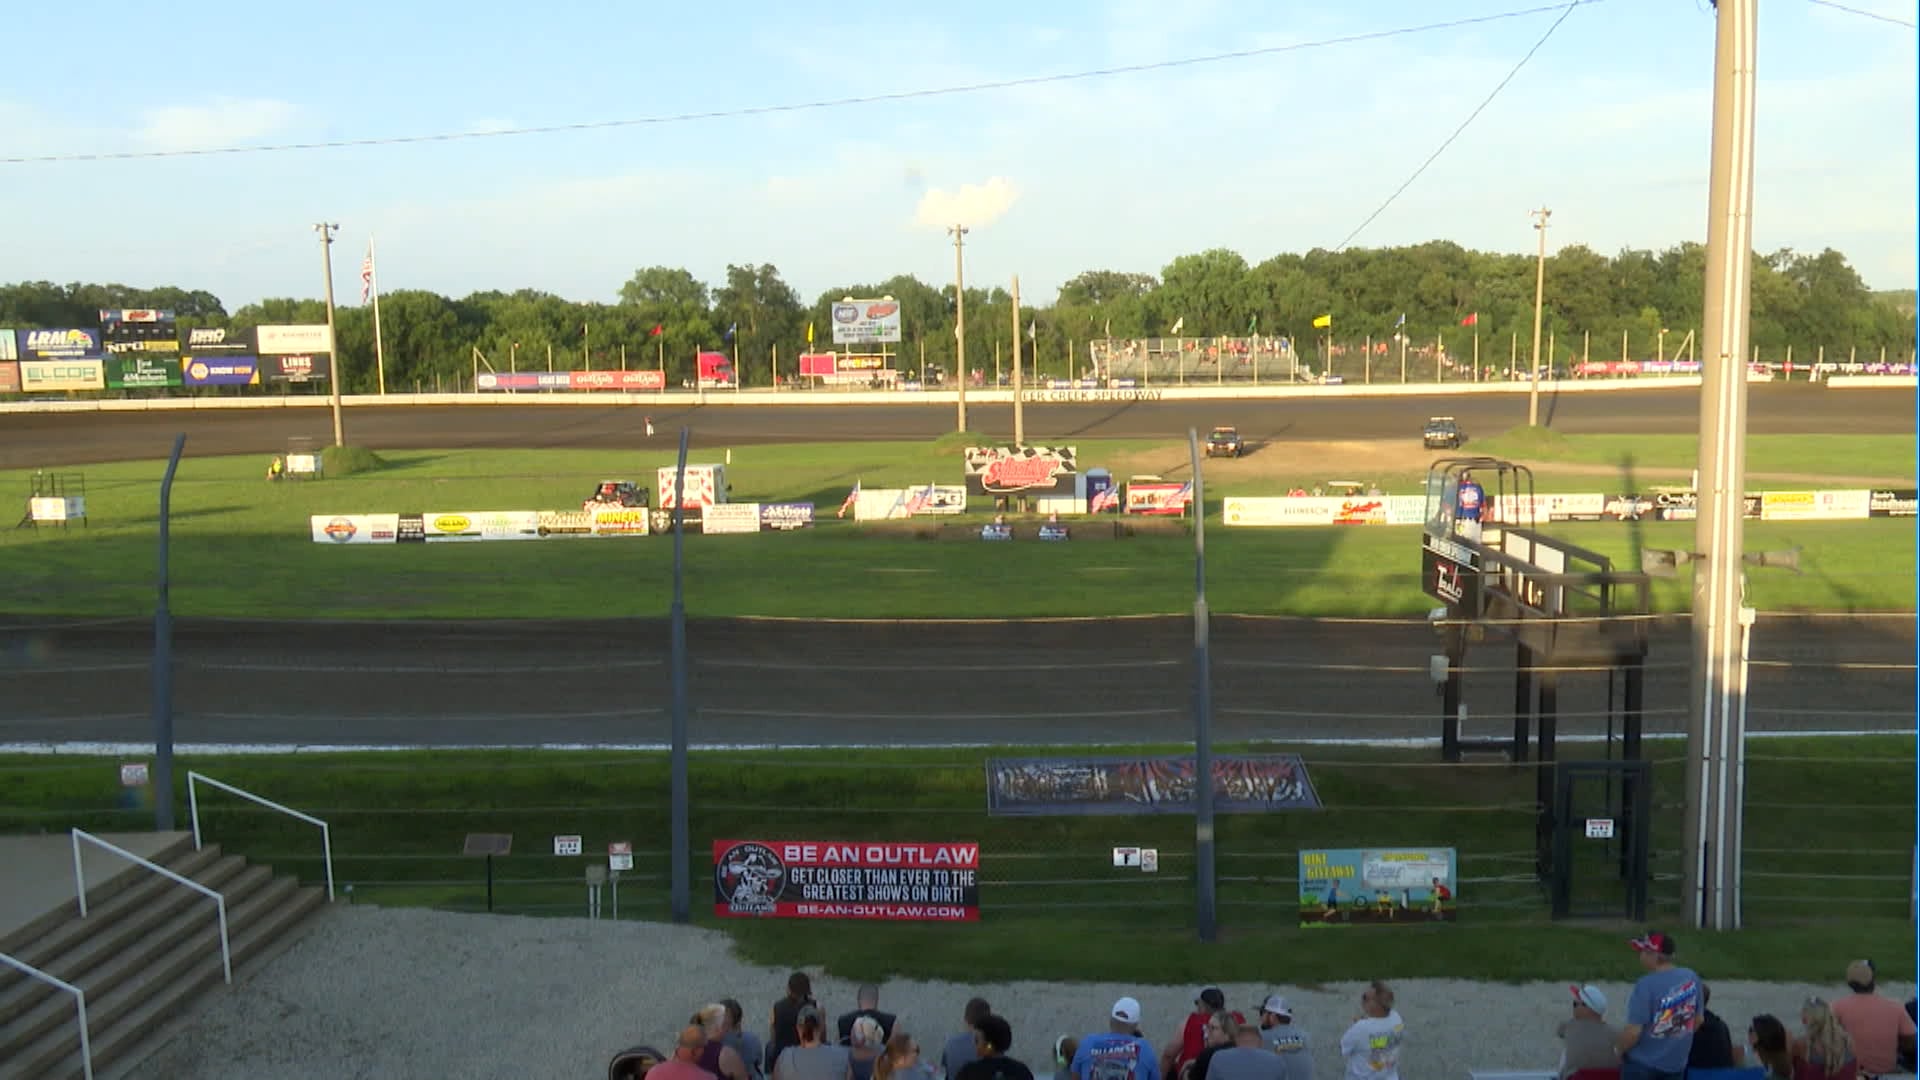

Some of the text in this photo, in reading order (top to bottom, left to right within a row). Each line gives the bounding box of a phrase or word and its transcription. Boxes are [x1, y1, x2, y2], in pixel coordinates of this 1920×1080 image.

[27, 331, 67, 345] LRM
[1050, 390, 1089, 400] CREEK
[1095, 389, 1162, 400] SPEEDWAY
[784, 845, 976, 865] BE AN OUTLAW
[791, 868, 974, 886] GET CLOSER THAN EVER TO THE
[803, 885, 964, 903] GREATEST SHOWS ON DIRT!
[797, 904, 966, 918] BE-AN-OUTLAW.COM
